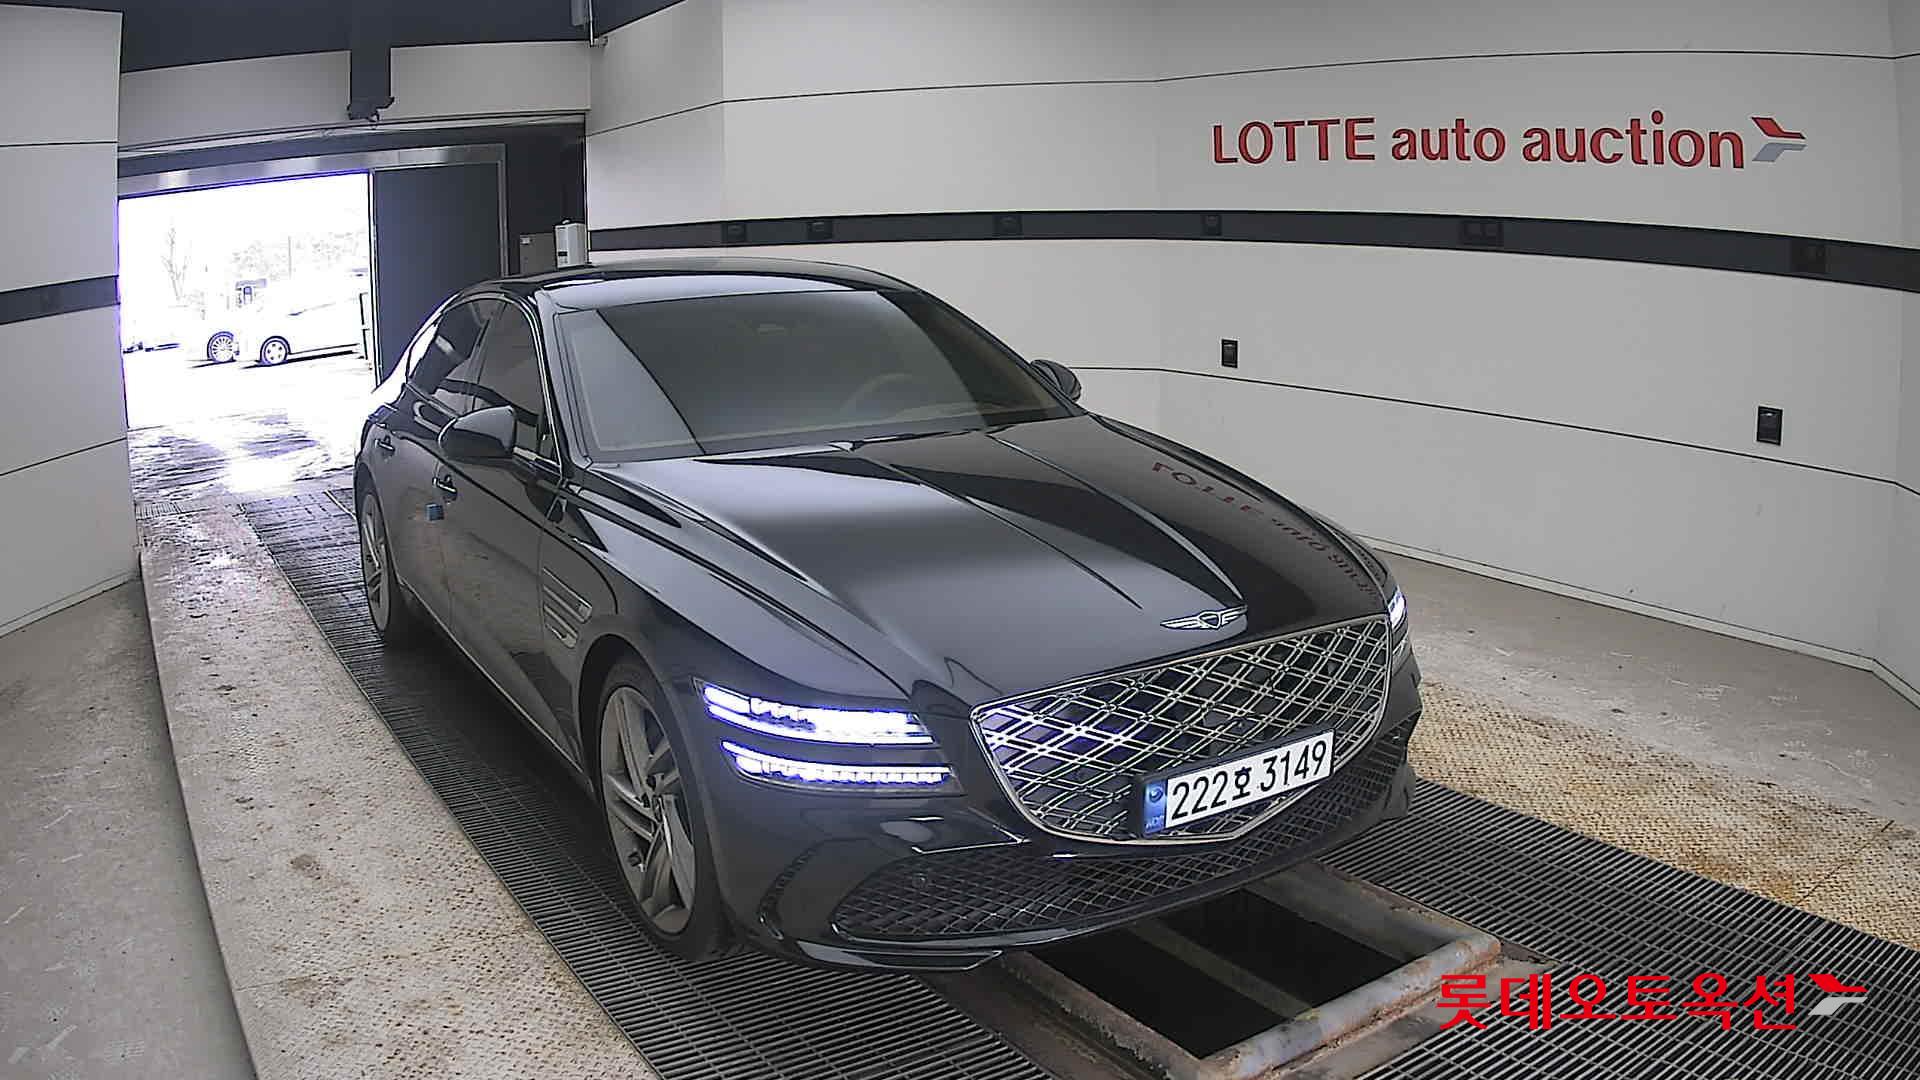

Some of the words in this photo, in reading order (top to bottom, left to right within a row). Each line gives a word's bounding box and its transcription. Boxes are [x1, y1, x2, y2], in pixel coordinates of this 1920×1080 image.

[1213, 117, 1376, 164] LOTTE
[1391, 118, 1506, 162] auto
[1522, 110, 1745, 169] auction
[1259, 740, 1327, 793] 3149
